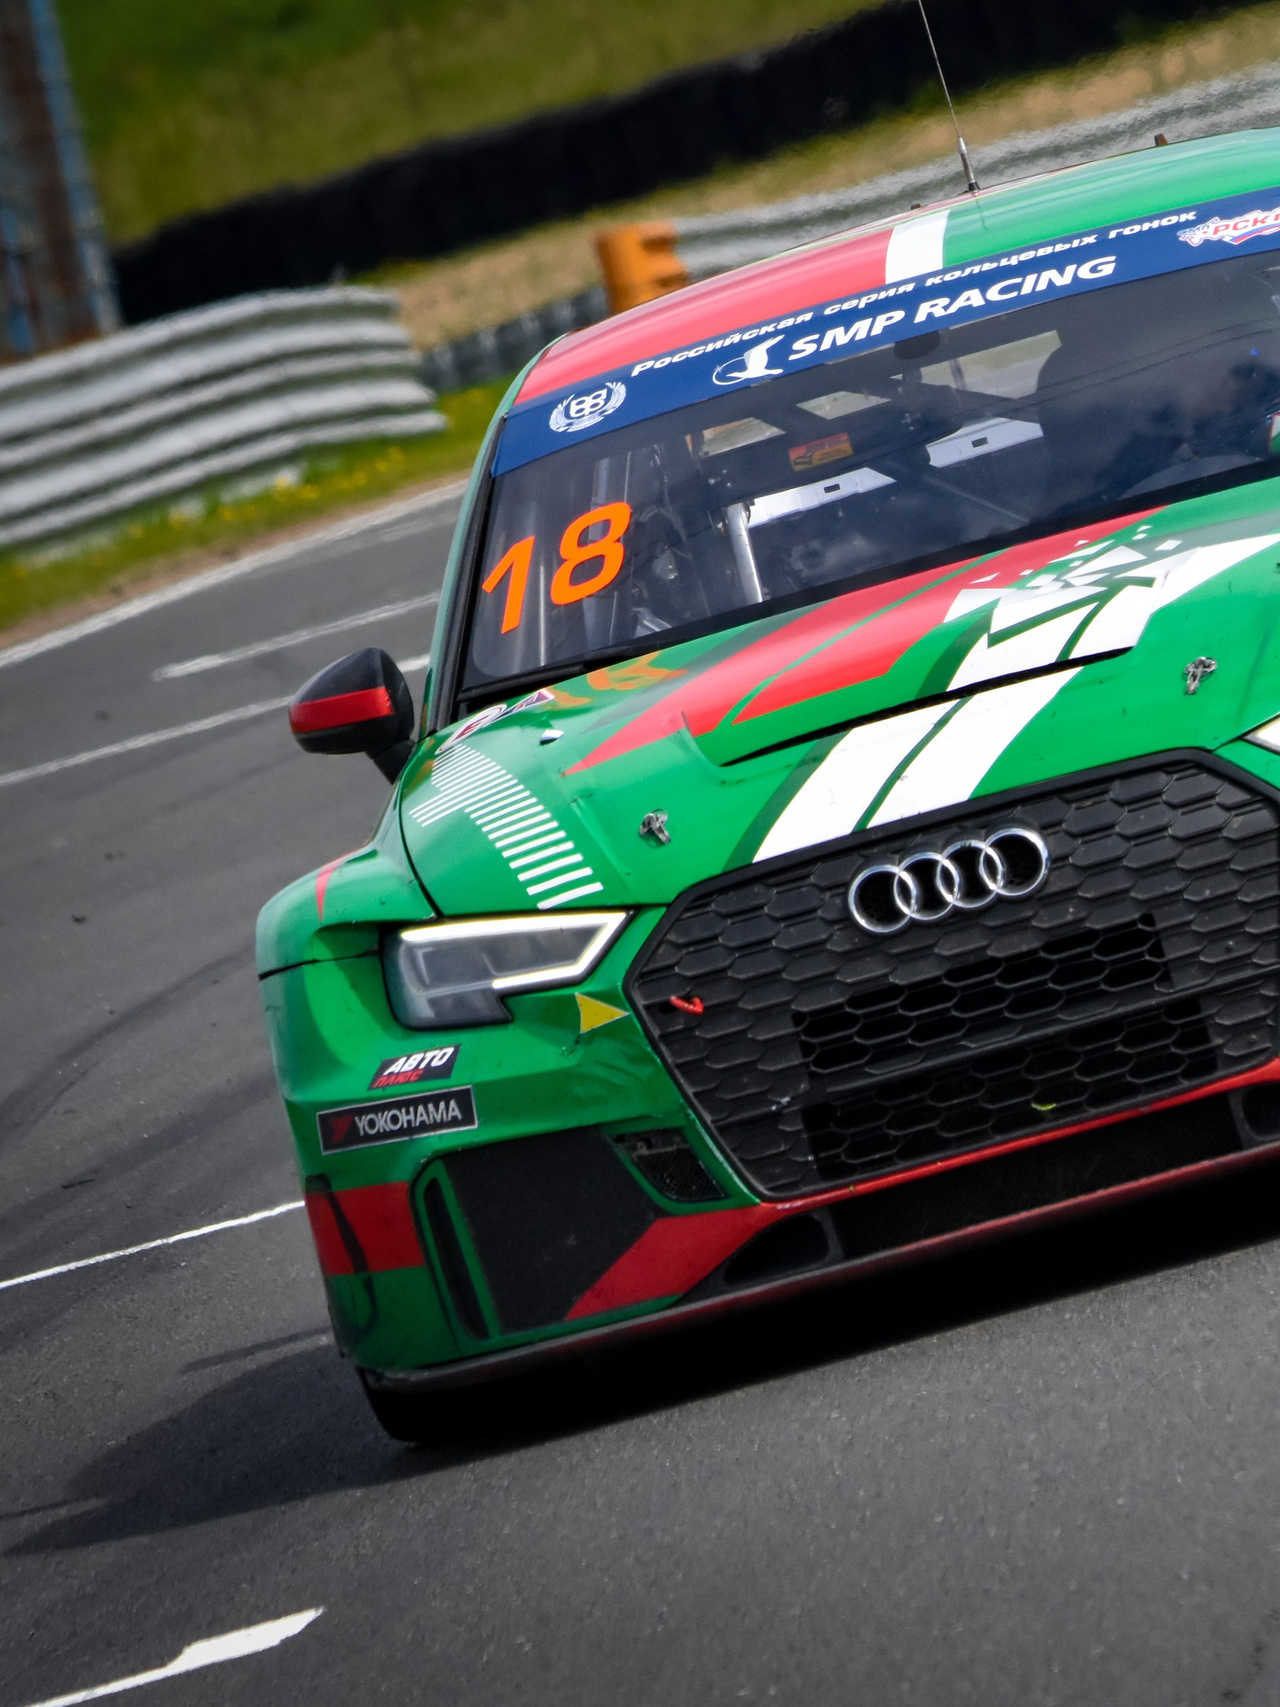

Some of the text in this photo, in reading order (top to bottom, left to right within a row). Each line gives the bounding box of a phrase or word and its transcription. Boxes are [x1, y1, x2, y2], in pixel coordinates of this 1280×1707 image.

[631, 211, 1197, 377] Российская серия кольцевых гонок
[788, 255, 1117, 361] SMP RACING
[481, 502, 632, 634] 18
[382, 1046, 455, 1076] АВТО
[354, 1099, 463, 1137] YOKOHAMA
